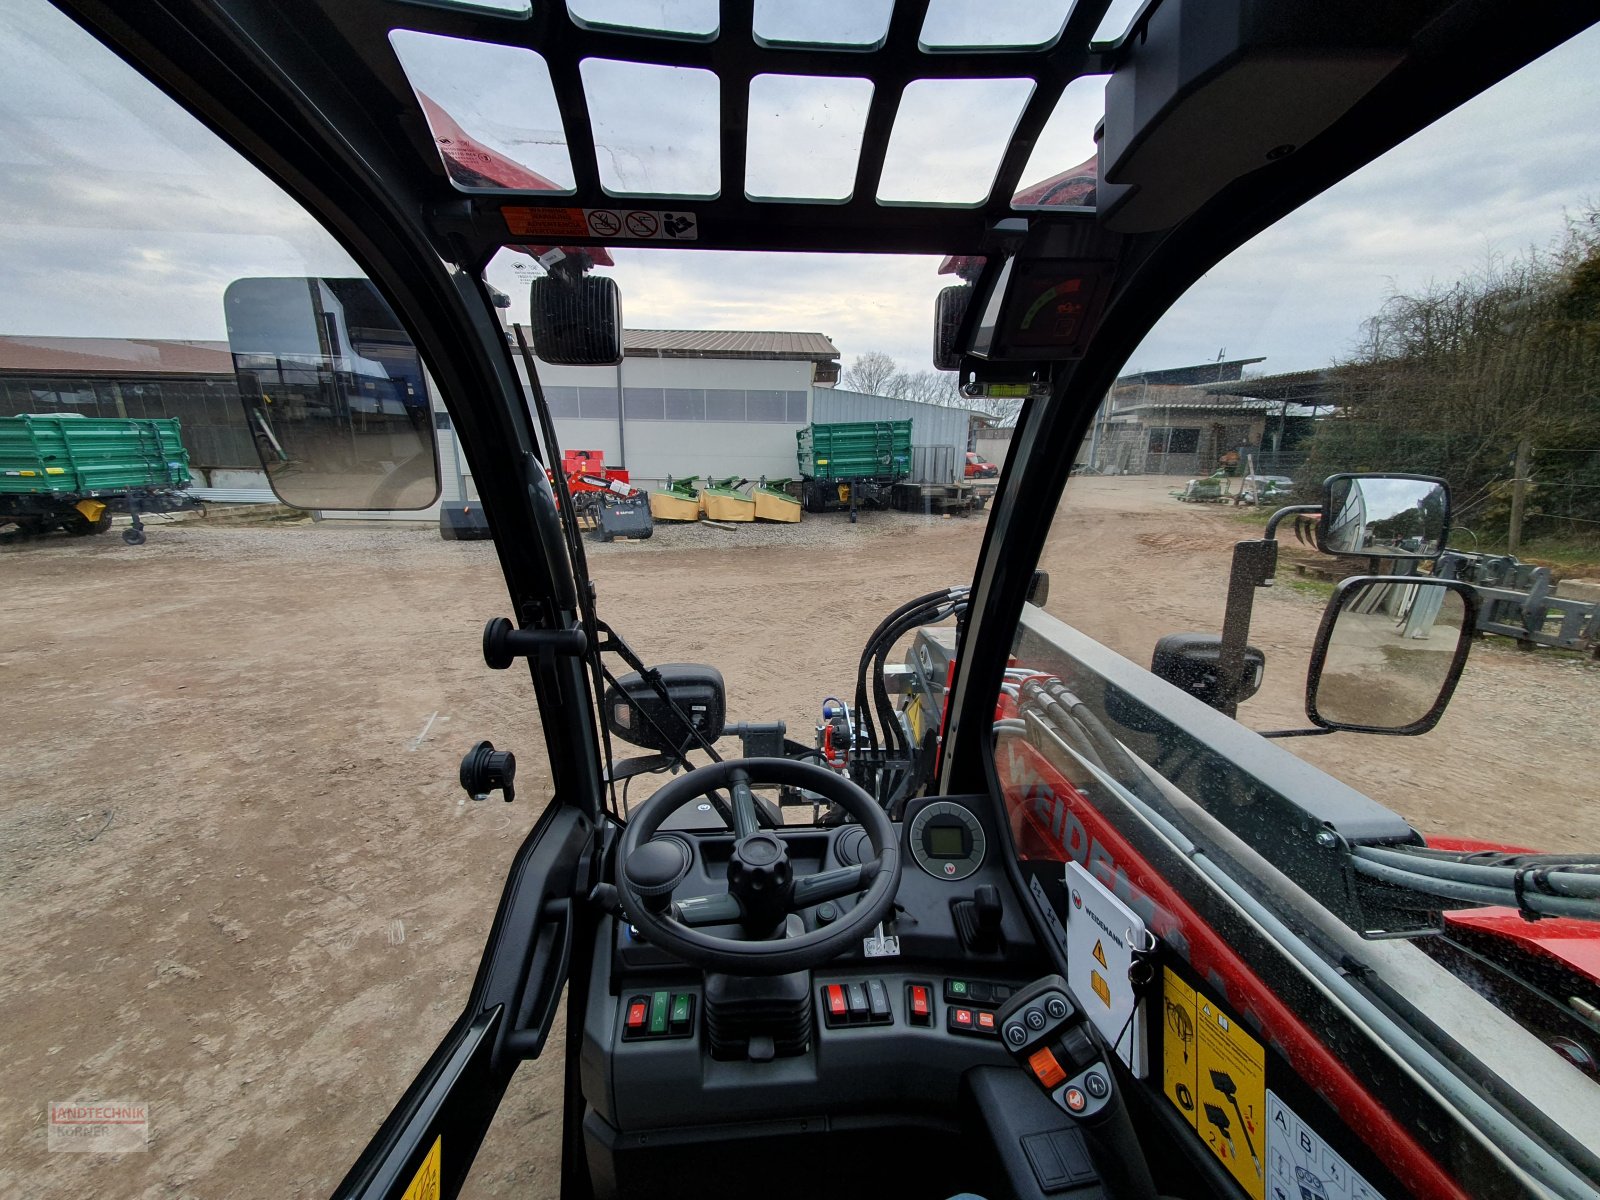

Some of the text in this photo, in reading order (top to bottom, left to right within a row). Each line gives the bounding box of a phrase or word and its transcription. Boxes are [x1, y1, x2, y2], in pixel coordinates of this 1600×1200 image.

[1084, 905, 1124, 950] WEIDEMANN
[1275, 1110, 1287, 1131] A
[1300, 1131, 1312, 1153] B
